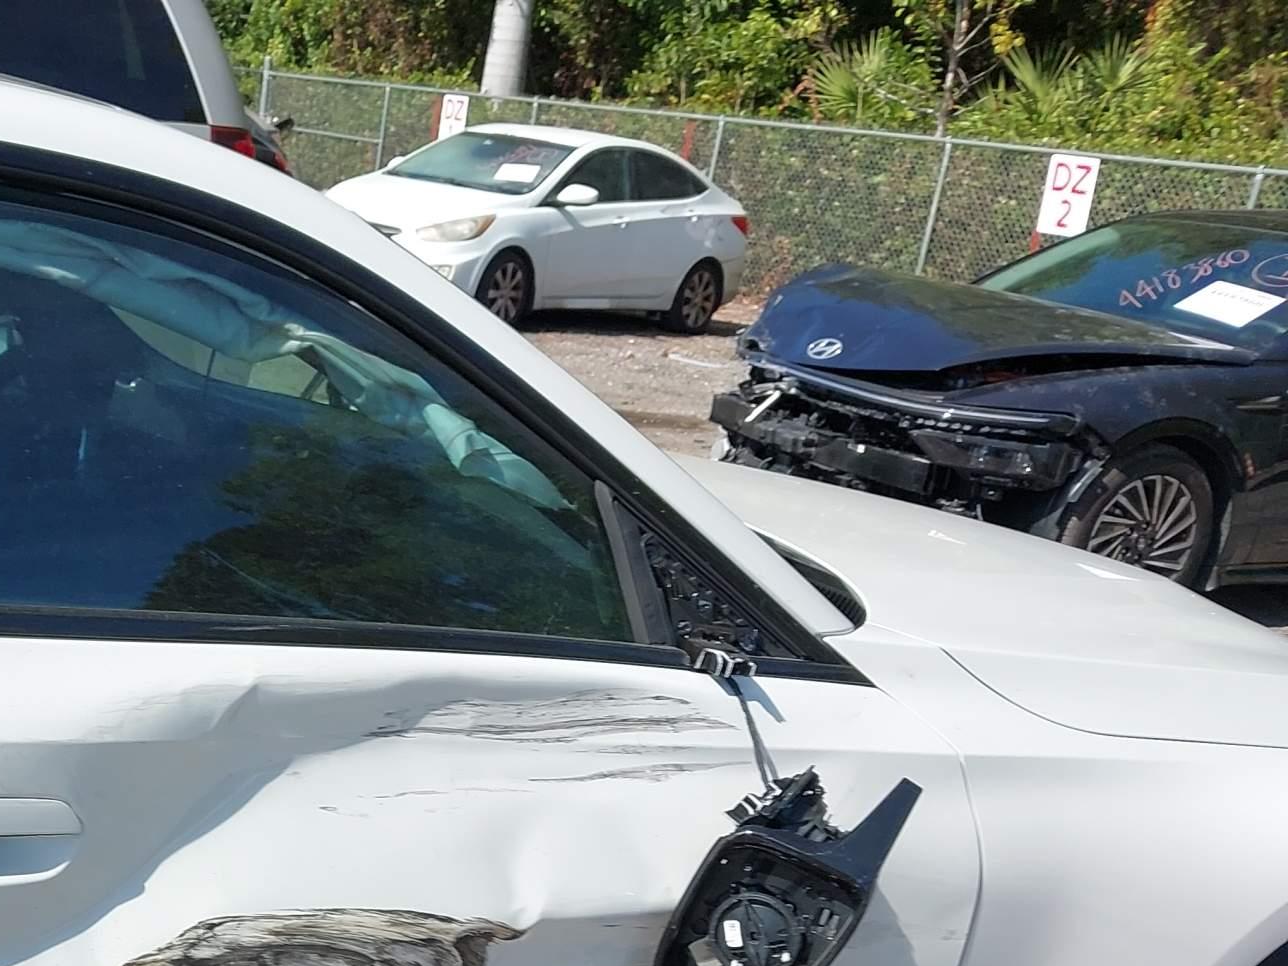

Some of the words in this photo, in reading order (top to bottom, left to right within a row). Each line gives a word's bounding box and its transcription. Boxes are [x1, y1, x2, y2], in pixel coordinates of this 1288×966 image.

[445, 99, 464, 121] DZ
[1052, 163, 1092, 195] DZ
[1056, 199, 1072, 228] 2
